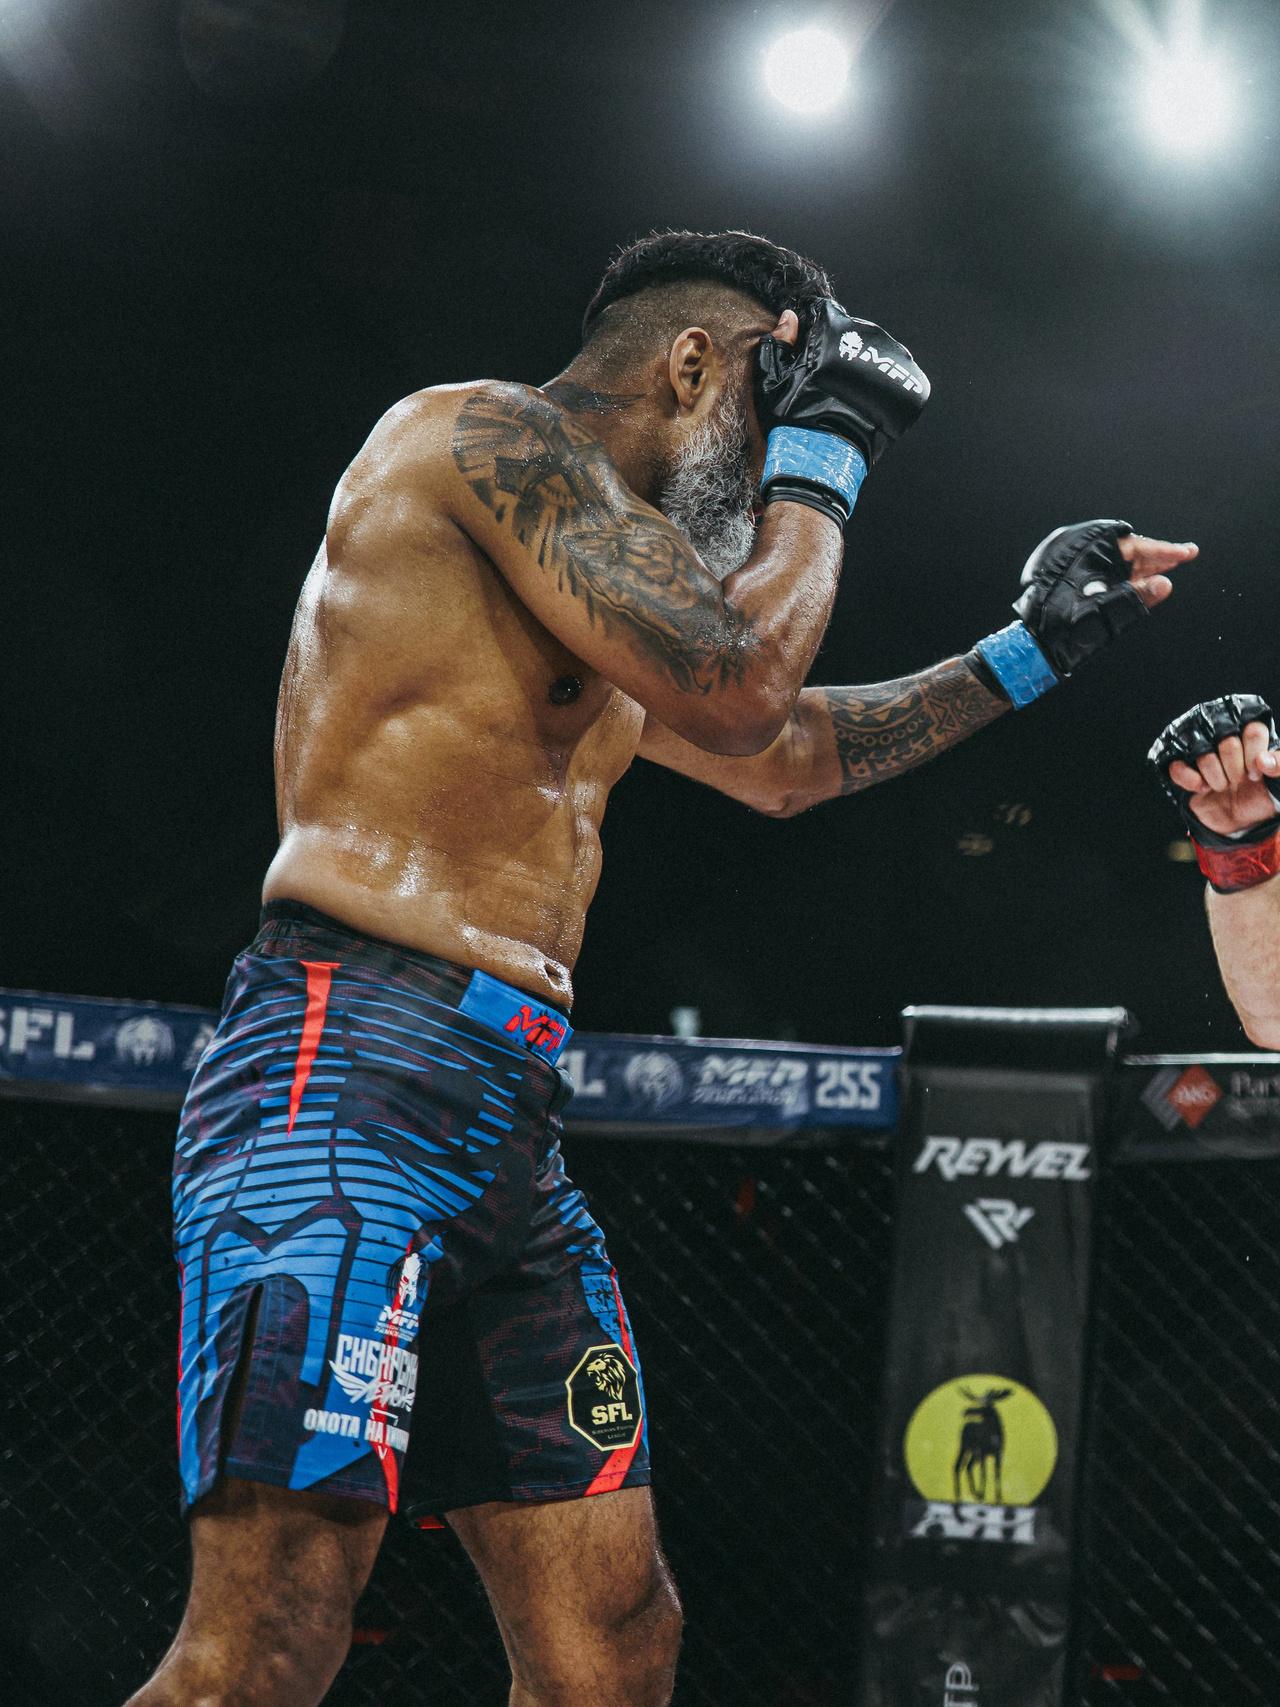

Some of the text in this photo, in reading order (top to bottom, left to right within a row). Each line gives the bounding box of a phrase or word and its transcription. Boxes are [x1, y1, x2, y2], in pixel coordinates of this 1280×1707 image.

[859, 346, 923, 394] MFP
[700, 1055, 809, 1087] MFP
[816, 1060, 882, 1110] 255
[303, 1408, 361, 1439] ОХОТА
[364, 1418, 384, 1444] НА
[591, 1402, 634, 1425] SFL
